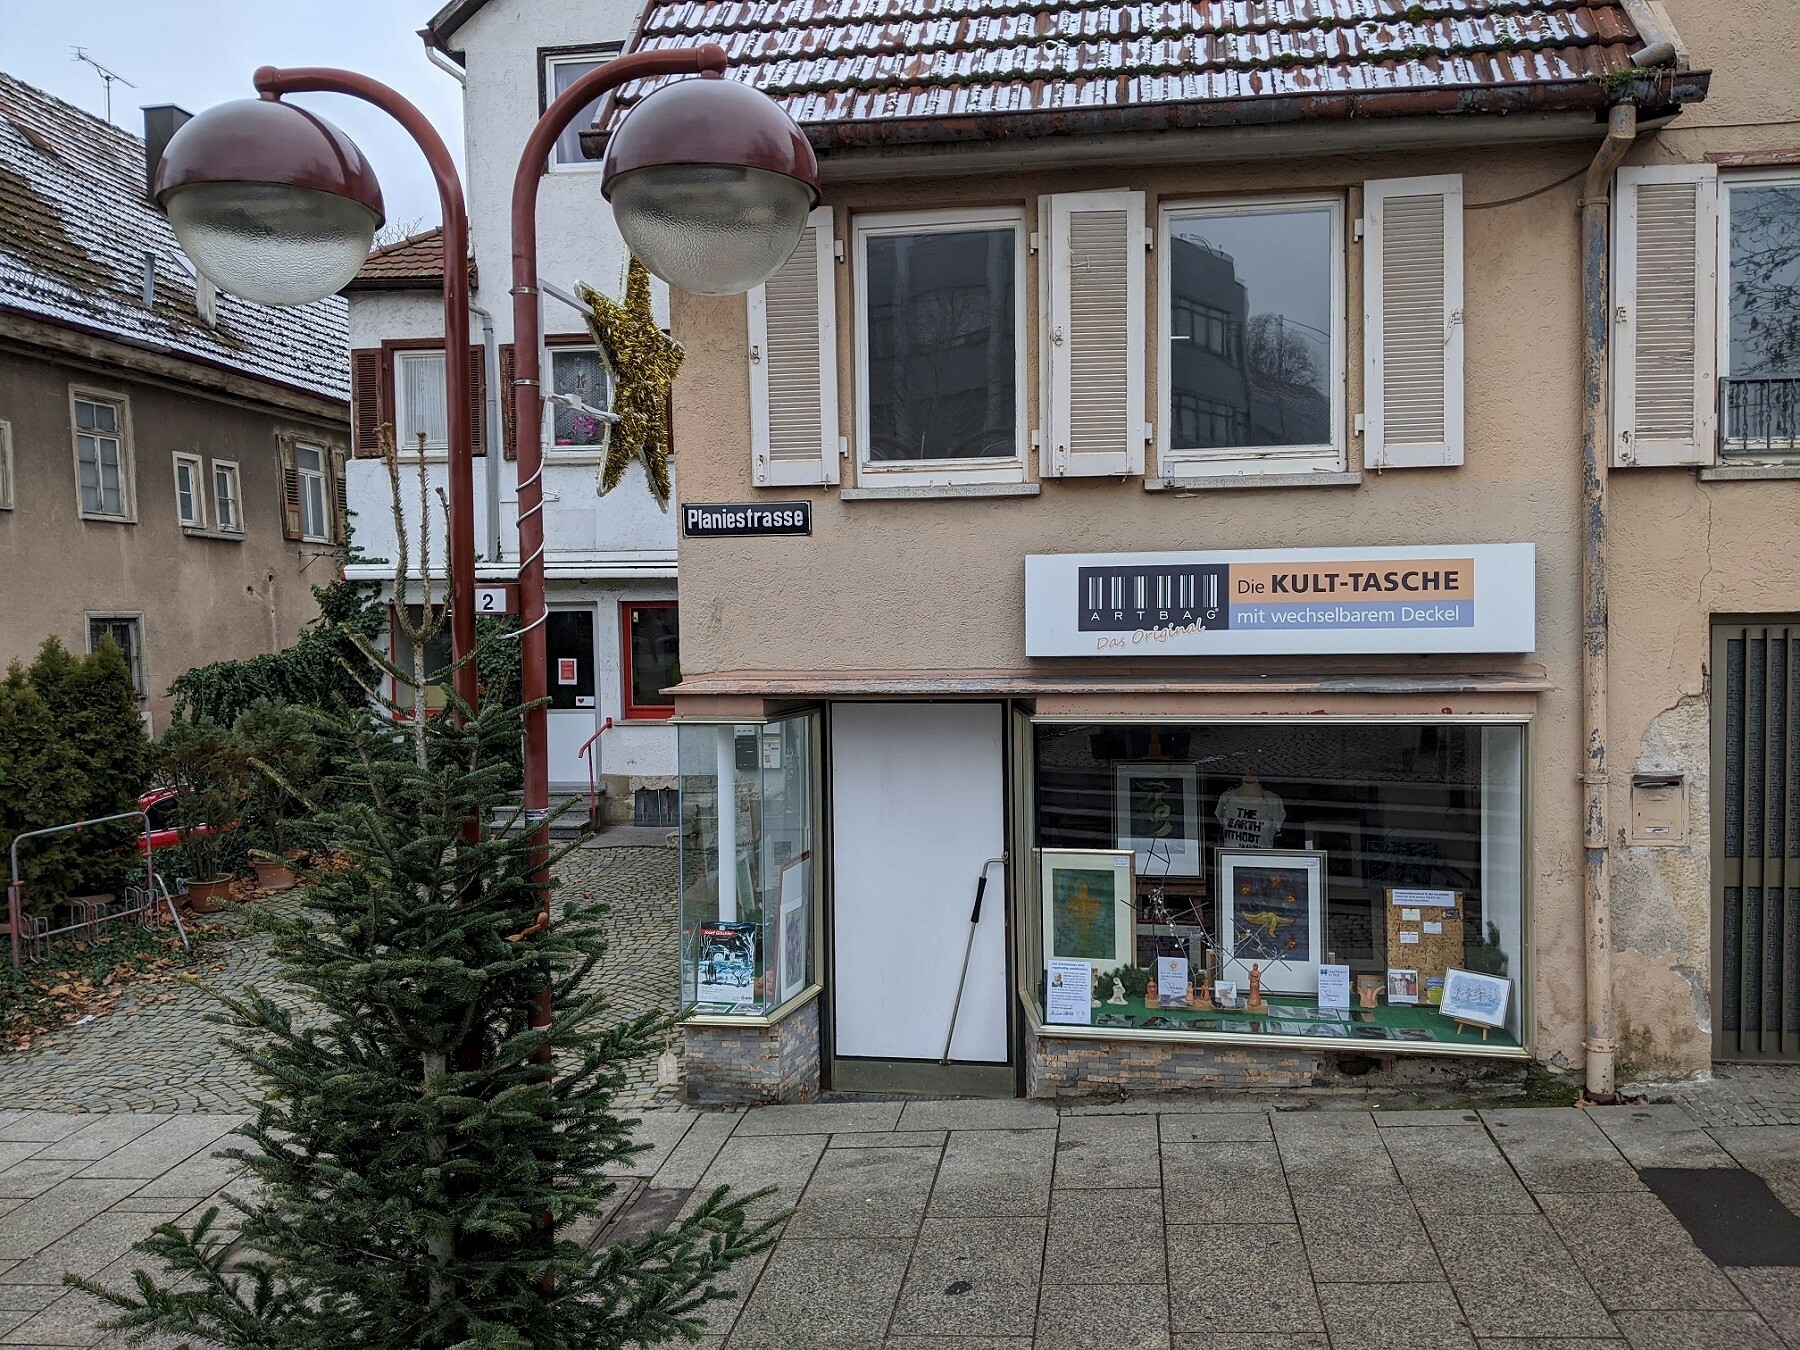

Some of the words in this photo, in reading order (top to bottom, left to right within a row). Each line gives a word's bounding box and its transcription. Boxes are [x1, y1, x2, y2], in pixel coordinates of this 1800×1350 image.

[687, 508, 804, 529] Planiestrasse
[1237, 579, 1265, 594] Die
[1271, 571, 1459, 593] KULT-TASCHE
[482, 593, 494, 611] 2
[1237, 608, 1266, 623] mit
[1271, 607, 1395, 624] wechselbarem
[1401, 605, 1460, 621] Deckel
[1096, 636, 1127, 651] Das
[1131, 616, 1206, 643] Original
[1237, 807, 1258, 820] THE
